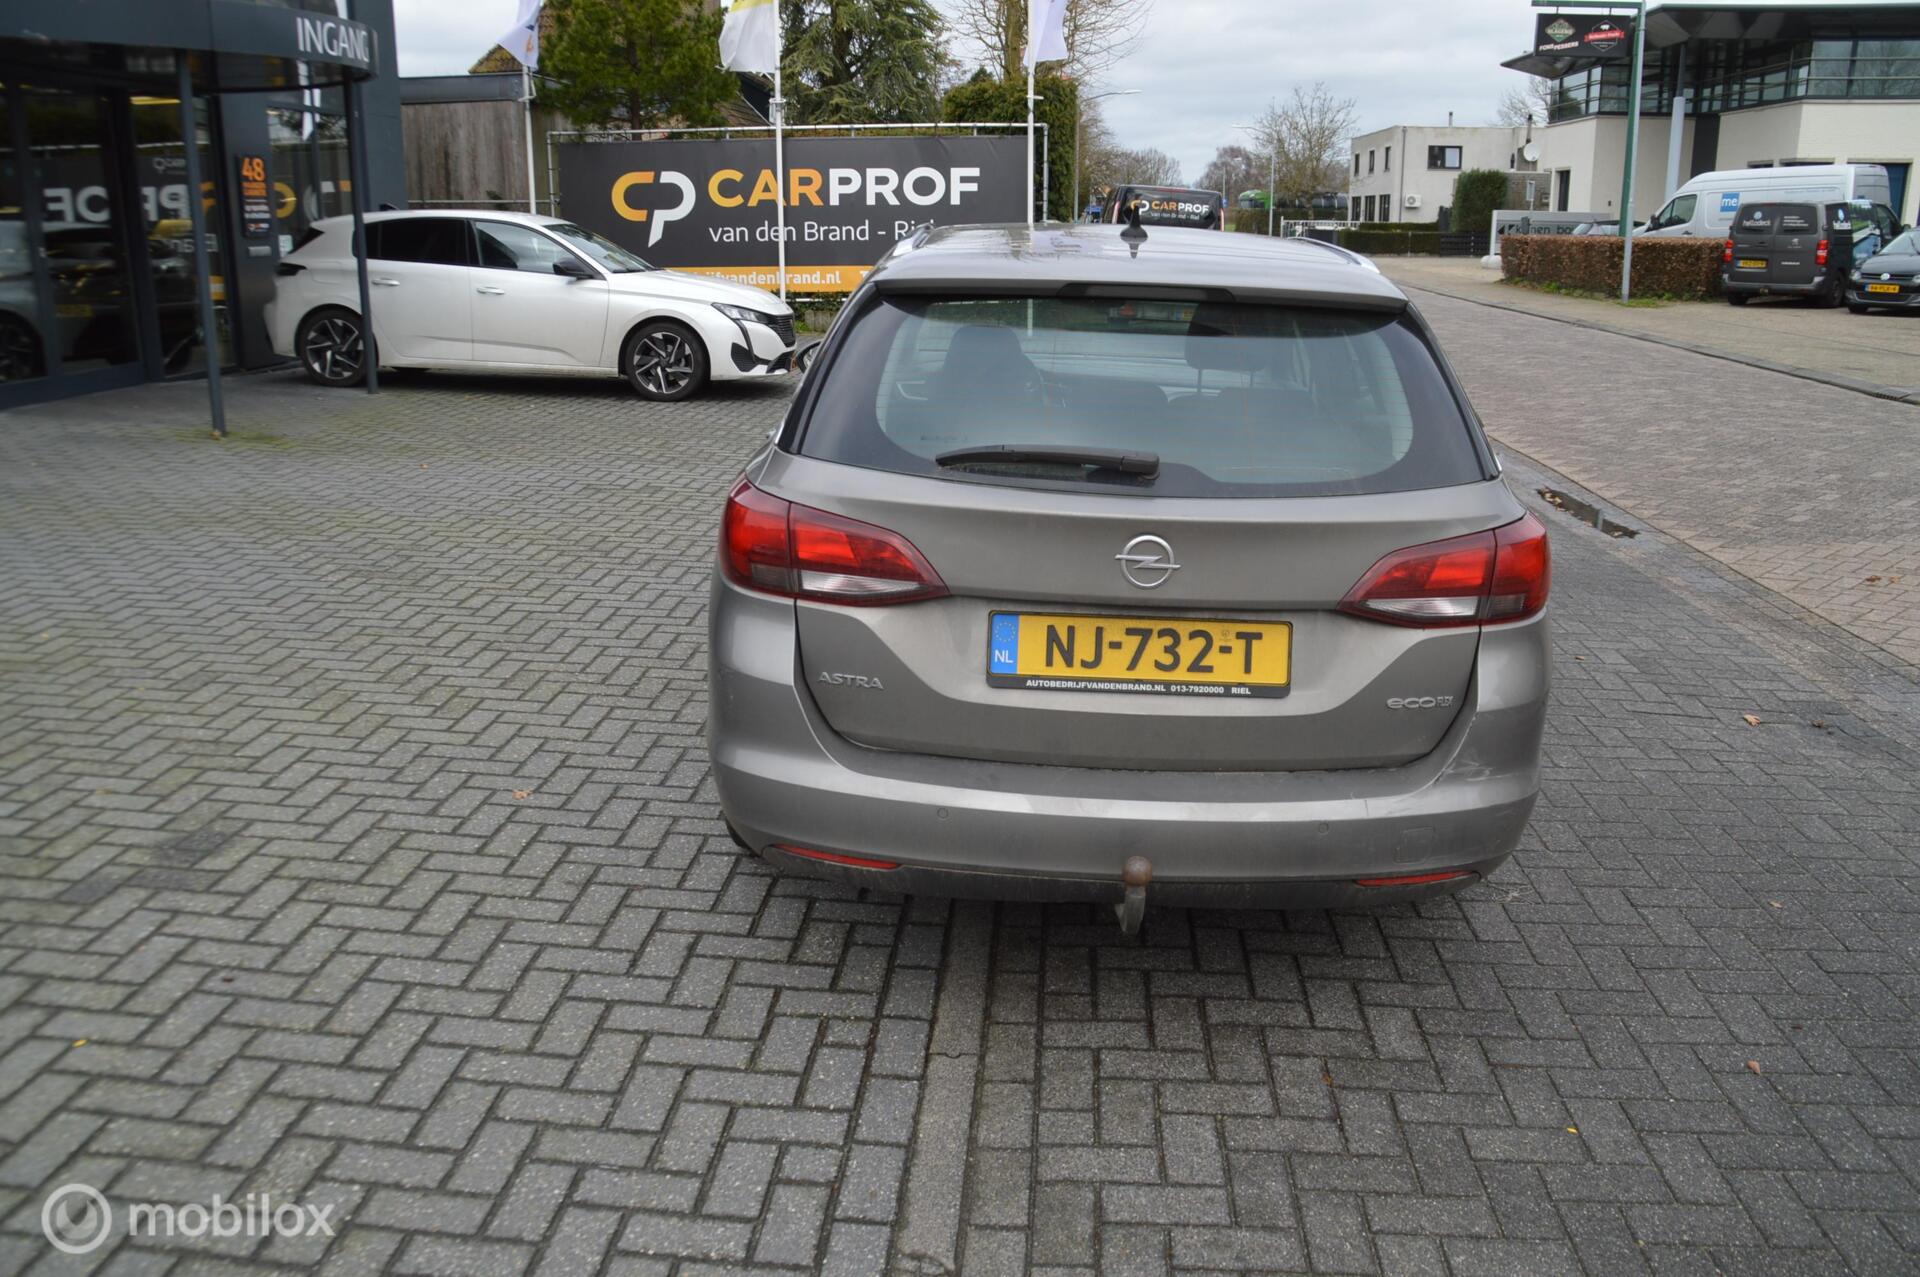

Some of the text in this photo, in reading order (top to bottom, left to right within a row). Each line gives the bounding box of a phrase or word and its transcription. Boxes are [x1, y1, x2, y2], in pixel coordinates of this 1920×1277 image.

[296, 16, 370, 62] INGANG
[242, 157, 265, 181] 48
[708, 167, 981, 208] CARPROF
[1151, 200, 1210, 214] CARPROF
[709, 226, 748, 242] van
[756, 220, 796, 242] den
[804, 219, 869, 241] Brand
[895, 219, 934, 240] Ri
[994, 625, 1263, 674] NL NJ-732-T
[818, 671, 884, 690] ASTRA
[1026, 679, 1251, 695] AUTOBEDRIJFVANDENBRAND.NL 013-7920000 RIEL
